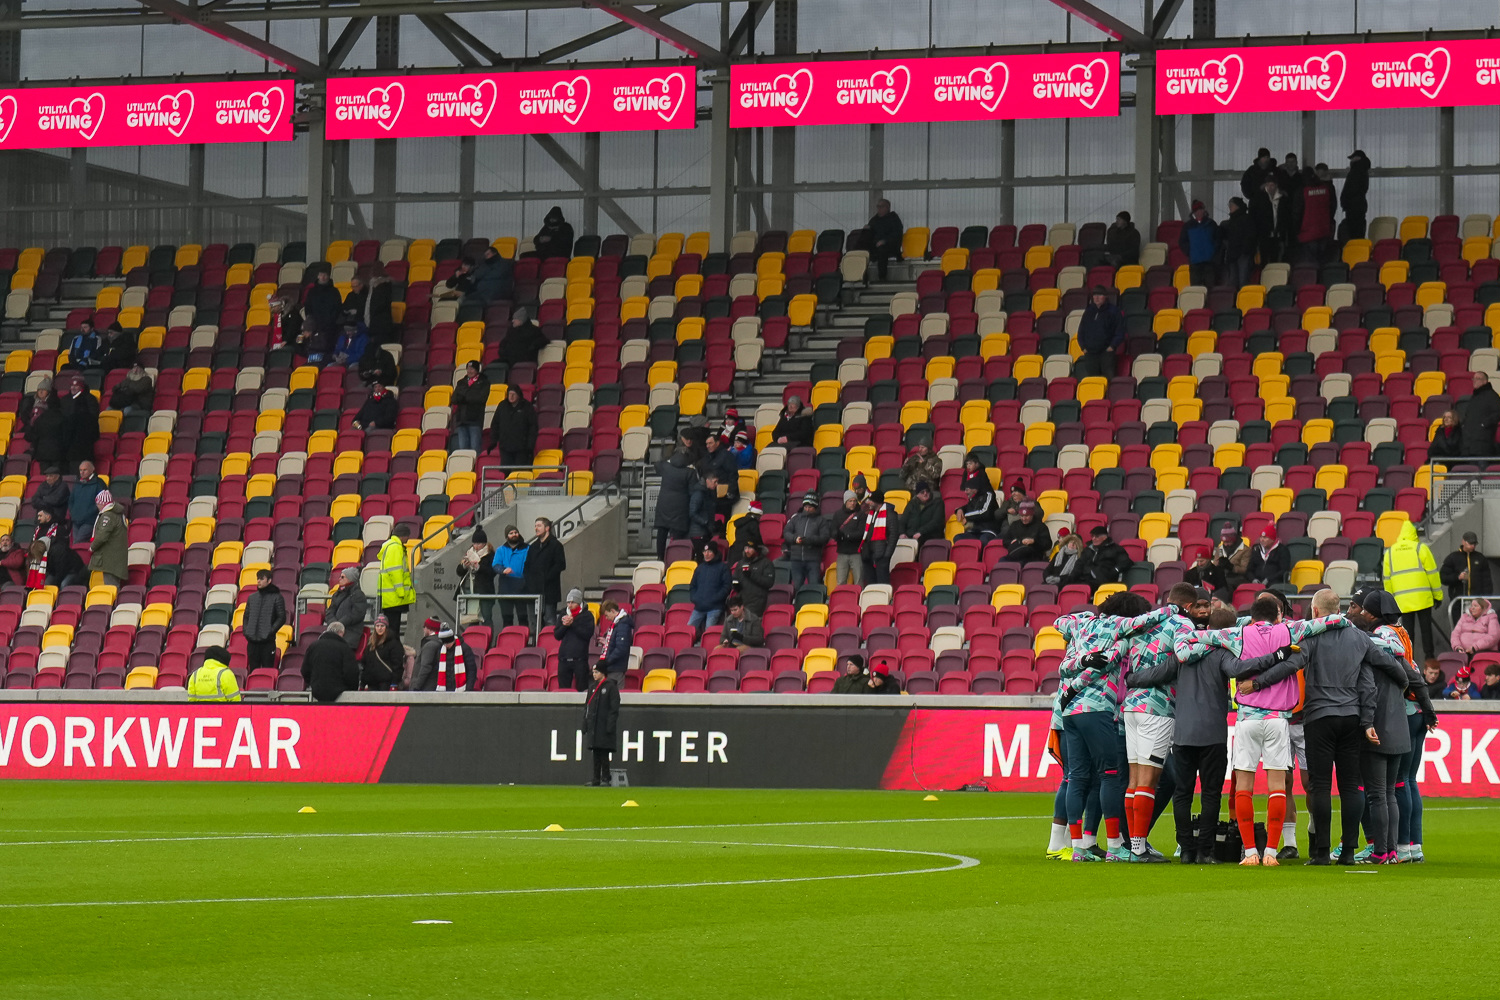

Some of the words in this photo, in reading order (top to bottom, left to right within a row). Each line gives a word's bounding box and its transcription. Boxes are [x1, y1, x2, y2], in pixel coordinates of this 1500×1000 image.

[1167, 68, 1200, 77] UTILITA
[1269, 65, 1302, 74] UTILITA
[1372, 62, 1406, 71] UTILITA
[837, 79, 868, 88] UTILITA
[935, 76, 966, 85] UTILITA
[1034, 73, 1066, 82] UTILITA
[1268, 75, 1330, 91] GIVING
[1372, 71, 1435, 88] GIVING
[614, 86, 644, 95] UTILITA
[741, 83, 772, 91] UTILITA
[934, 85, 994, 101] GIVING
[1034, 82, 1093, 98] GIVING
[1167, 78, 1228, 94] GIVING
[336, 96, 365, 104] UTILITA
[428, 93, 457, 101] UTILITA
[520, 90, 550, 98] UTILITA
[741, 92, 798, 108] GIVING
[837, 88, 895, 104] GIVING
[39, 106, 67, 114] UTILITA
[127, 103, 156, 111] UTILITA
[216, 100, 246, 108] UTILITA
[427, 102, 483, 117] GIVING
[520, 99, 576, 114] GIVING
[614, 96, 671, 111] GIVING
[127, 112, 180, 127] GIVING
[216, 109, 270, 124] GIVING
[336, 104, 391, 120] GIVING
[38, 115, 92, 130] GIVING
[551, 730, 728, 763] LIHTER
